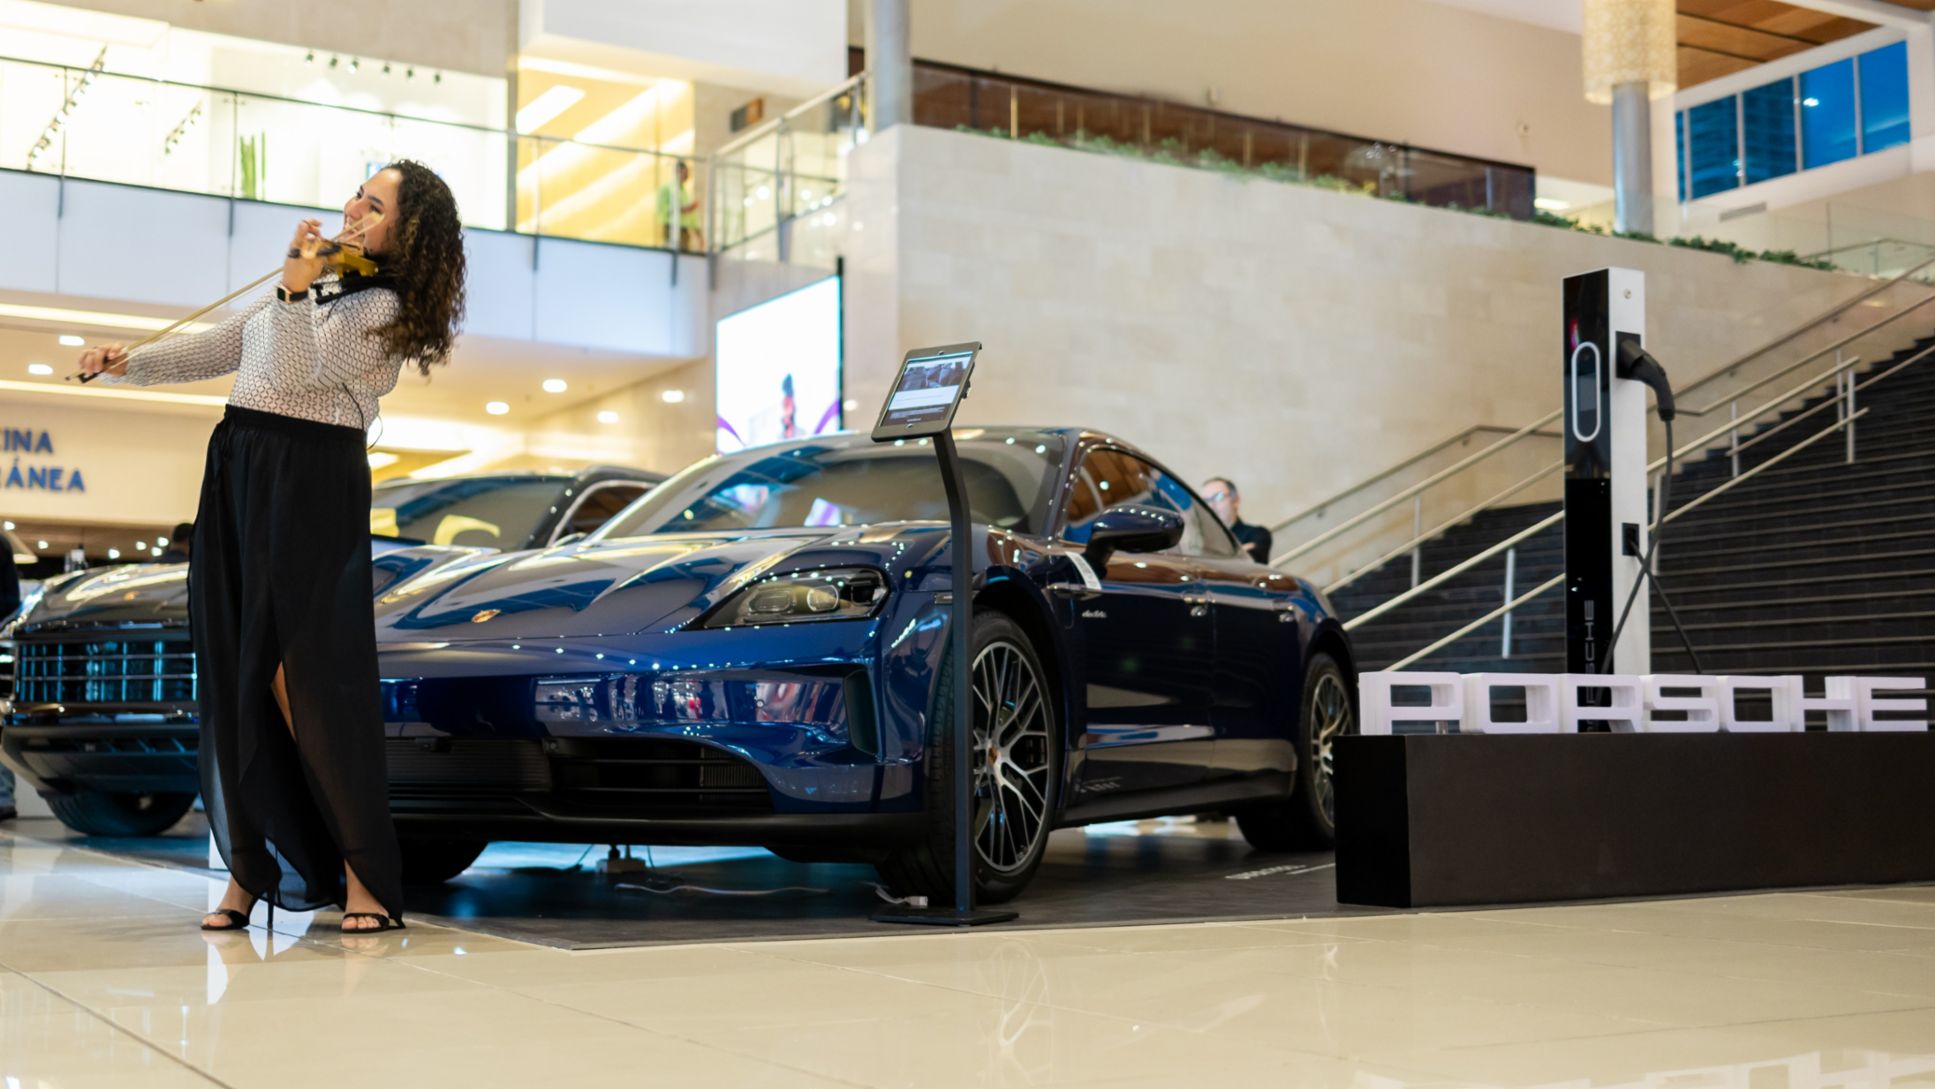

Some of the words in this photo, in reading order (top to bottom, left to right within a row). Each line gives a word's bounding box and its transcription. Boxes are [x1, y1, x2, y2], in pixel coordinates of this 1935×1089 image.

[0, 428, 54, 454] INA
[0, 457, 86, 492] ÁNEA
[1358, 672, 1928, 735] PORSCHE
